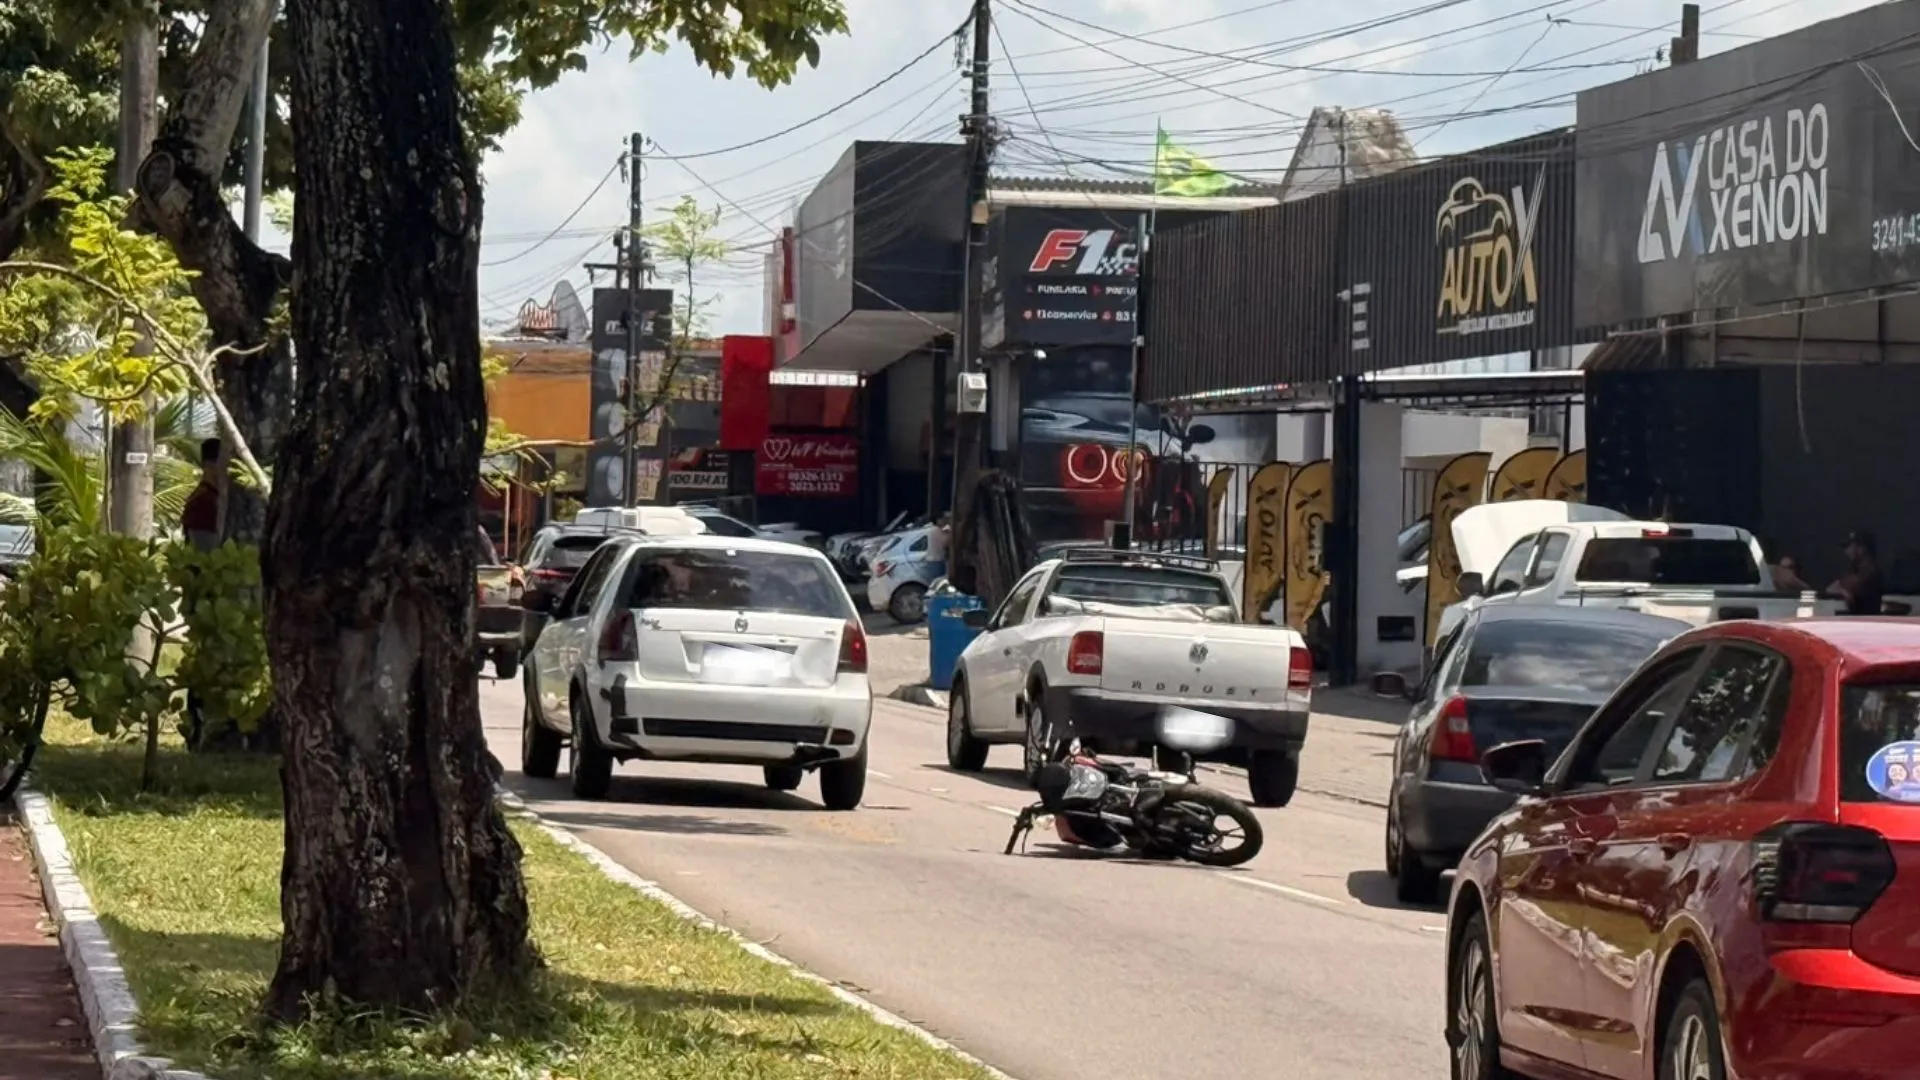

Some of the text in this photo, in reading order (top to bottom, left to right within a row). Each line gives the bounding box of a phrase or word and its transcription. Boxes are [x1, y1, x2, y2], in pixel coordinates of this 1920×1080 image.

[1708, 103, 1829, 190] CASA DO
[1029, 229, 1115, 275] F1
[1708, 168, 1828, 253] XENON
